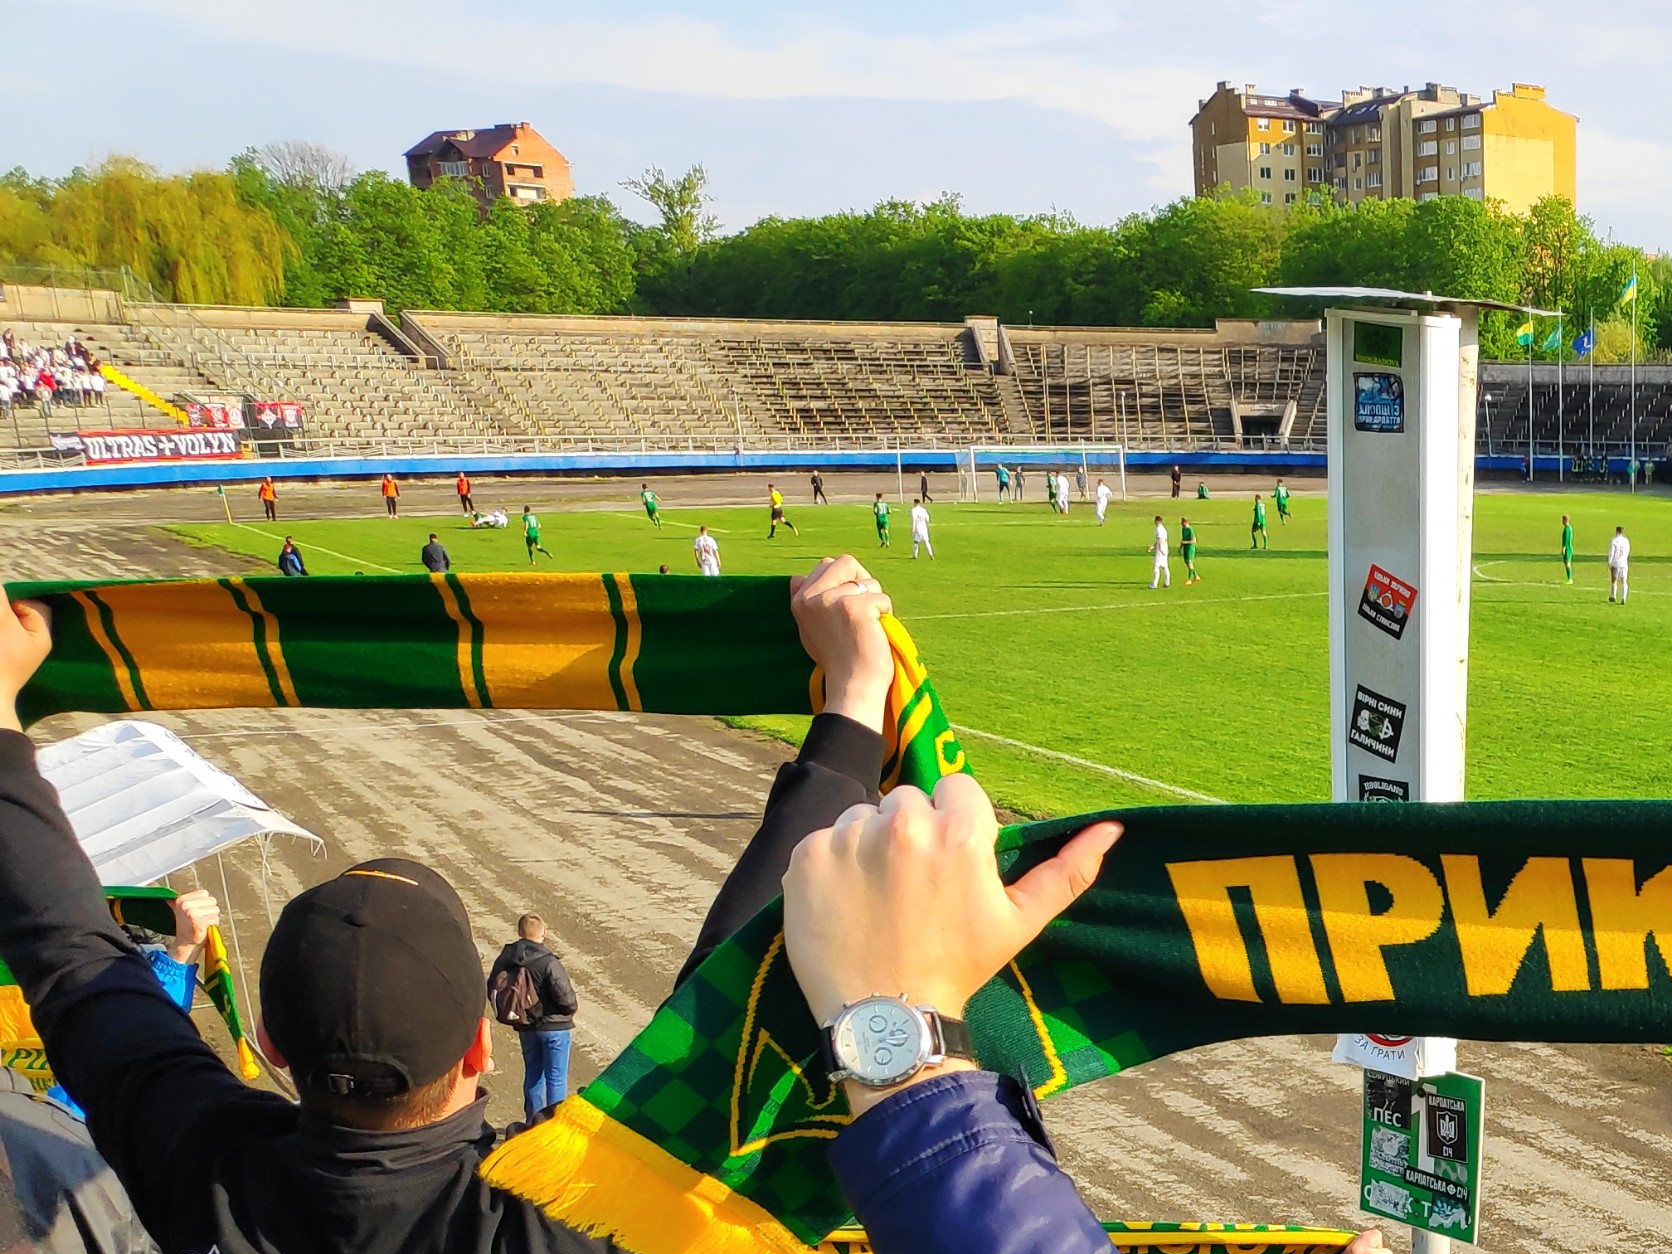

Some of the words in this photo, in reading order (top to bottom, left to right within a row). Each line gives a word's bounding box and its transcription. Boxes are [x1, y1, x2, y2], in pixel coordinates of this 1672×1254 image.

[82, 434, 158, 460] ULTRAS
[174, 432, 237, 456] VOLYN
[1357, 691, 1377, 709] ВІРНІ
[1378, 701, 1403, 719] СИНИ
[1350, 728, 1395, 758] ГАЛИЧИНИ
[1354, 1035, 1369, 1051] ЗА
[1371, 1046, 1406, 1060] ГРАТИ
[1372, 1106, 1402, 1127] ПЕС
[1429, 1095, 1465, 1113] КАРПАТСЬКА
[1443, 1146, 1453, 1158] СІЧ
[1405, 1169, 1446, 1193] КАРПАТСЬКА
[1456, 1186, 1468, 1200] СІЧ
